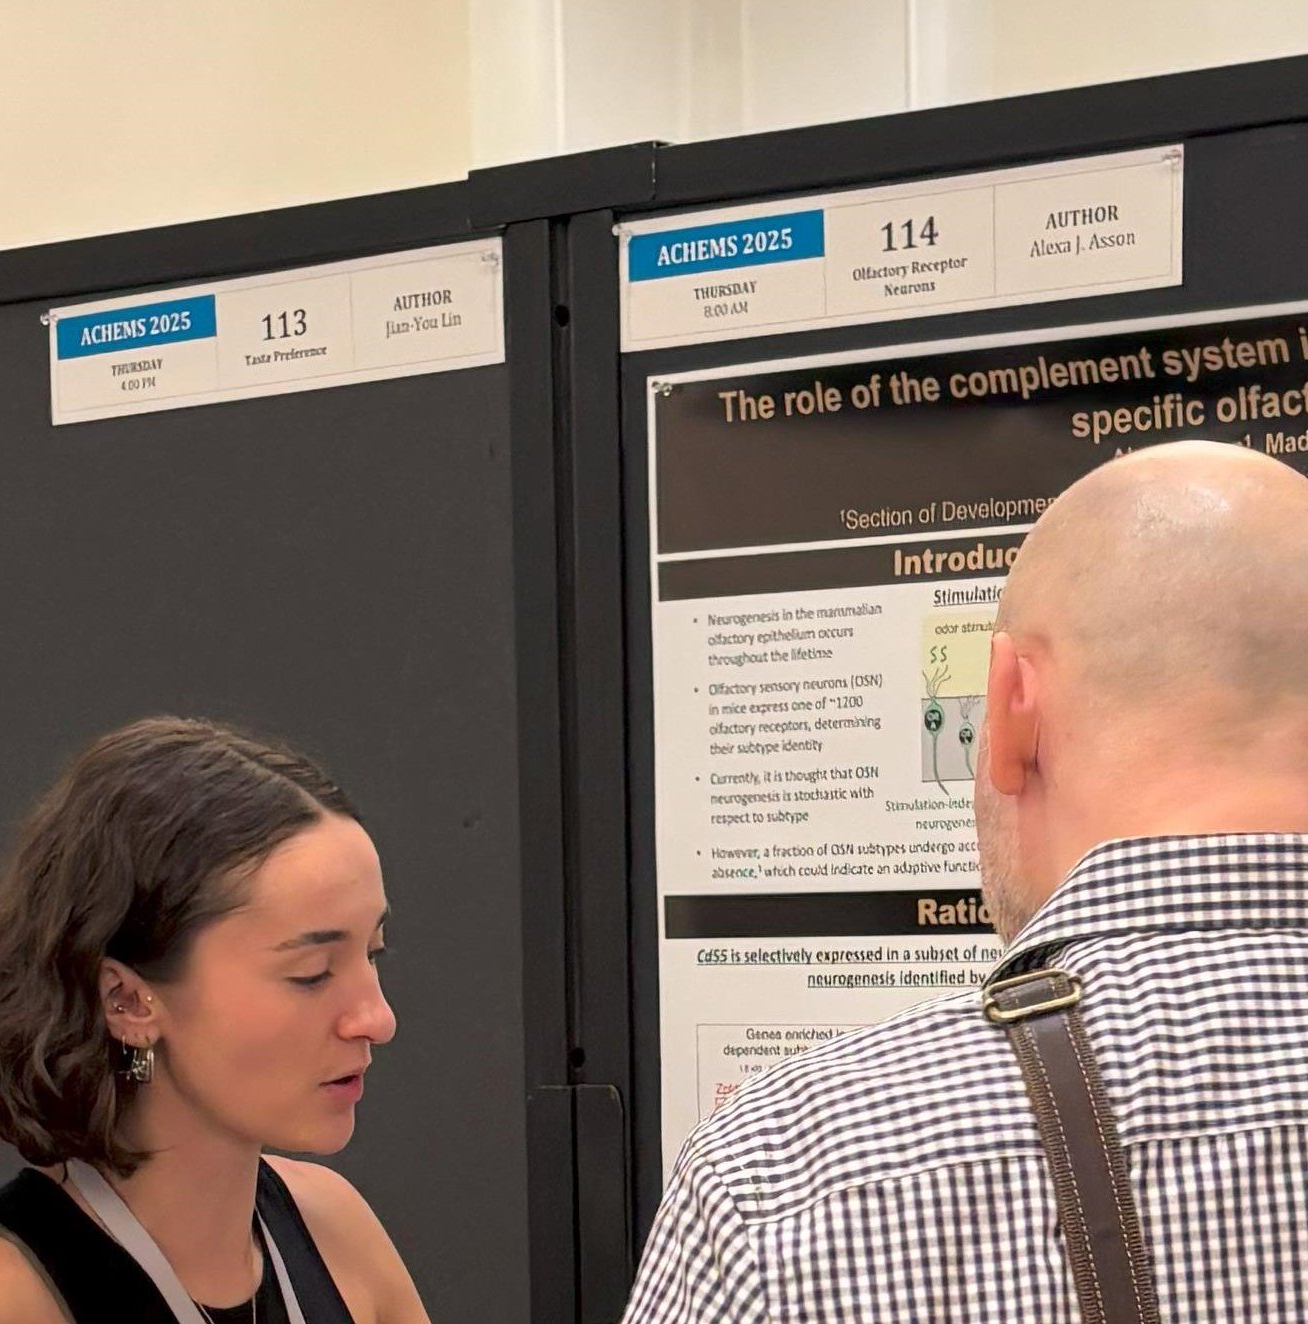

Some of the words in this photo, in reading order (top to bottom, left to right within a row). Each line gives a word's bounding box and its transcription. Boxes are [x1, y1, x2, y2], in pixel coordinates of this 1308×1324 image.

[1044, 203, 1119, 230] AUTHOR
[880, 214, 939, 252] 114
[1028, 237, 1072, 259] Alexa
[1074, 233, 1086, 256] J.
[1087, 231, 1136, 251] Asson
[656, 235, 739, 267] ACHEMS
[740, 226, 793, 255] 2025
[851, 264, 910, 282] Olfactory
[910, 256, 969, 275] Receptor
[392, 288, 453, 312] AUTHOR
[692, 279, 757, 301] THURSDAY
[883, 280, 936, 297] Neurons
[79, 318, 148, 346] ACHEMS
[148, 309, 192, 336] 2025
[260, 307, 307, 341] 113
[440, 310, 462, 328] Lin
[272, 345, 328, 362] Preference
[110, 357, 164, 377] THURSDAY
[718, 390, 775, 423] The
[783, 380, 841, 417] role
[851, 374, 884, 408] of
[889, 371, 941, 406] the
[949, 346, 1155, 399] complement
[1163, 335, 1291, 384] system
[1070, 394, 1206, 445] specific
[917, 501, 937, 524] of
[707, 681, 757, 696] Olfactory
[758, 680, 801, 694] sensory
[801, 677, 849, 691] neurons
[729, 947, 741, 963] is
[743, 946, 813, 963] selectively
[814, 945, 883, 962] expressed
[885, 946, 899, 961] in
[902, 948, 911, 961] a
[913, 944, 959, 961] subset
[961, 943, 978, 961] of
